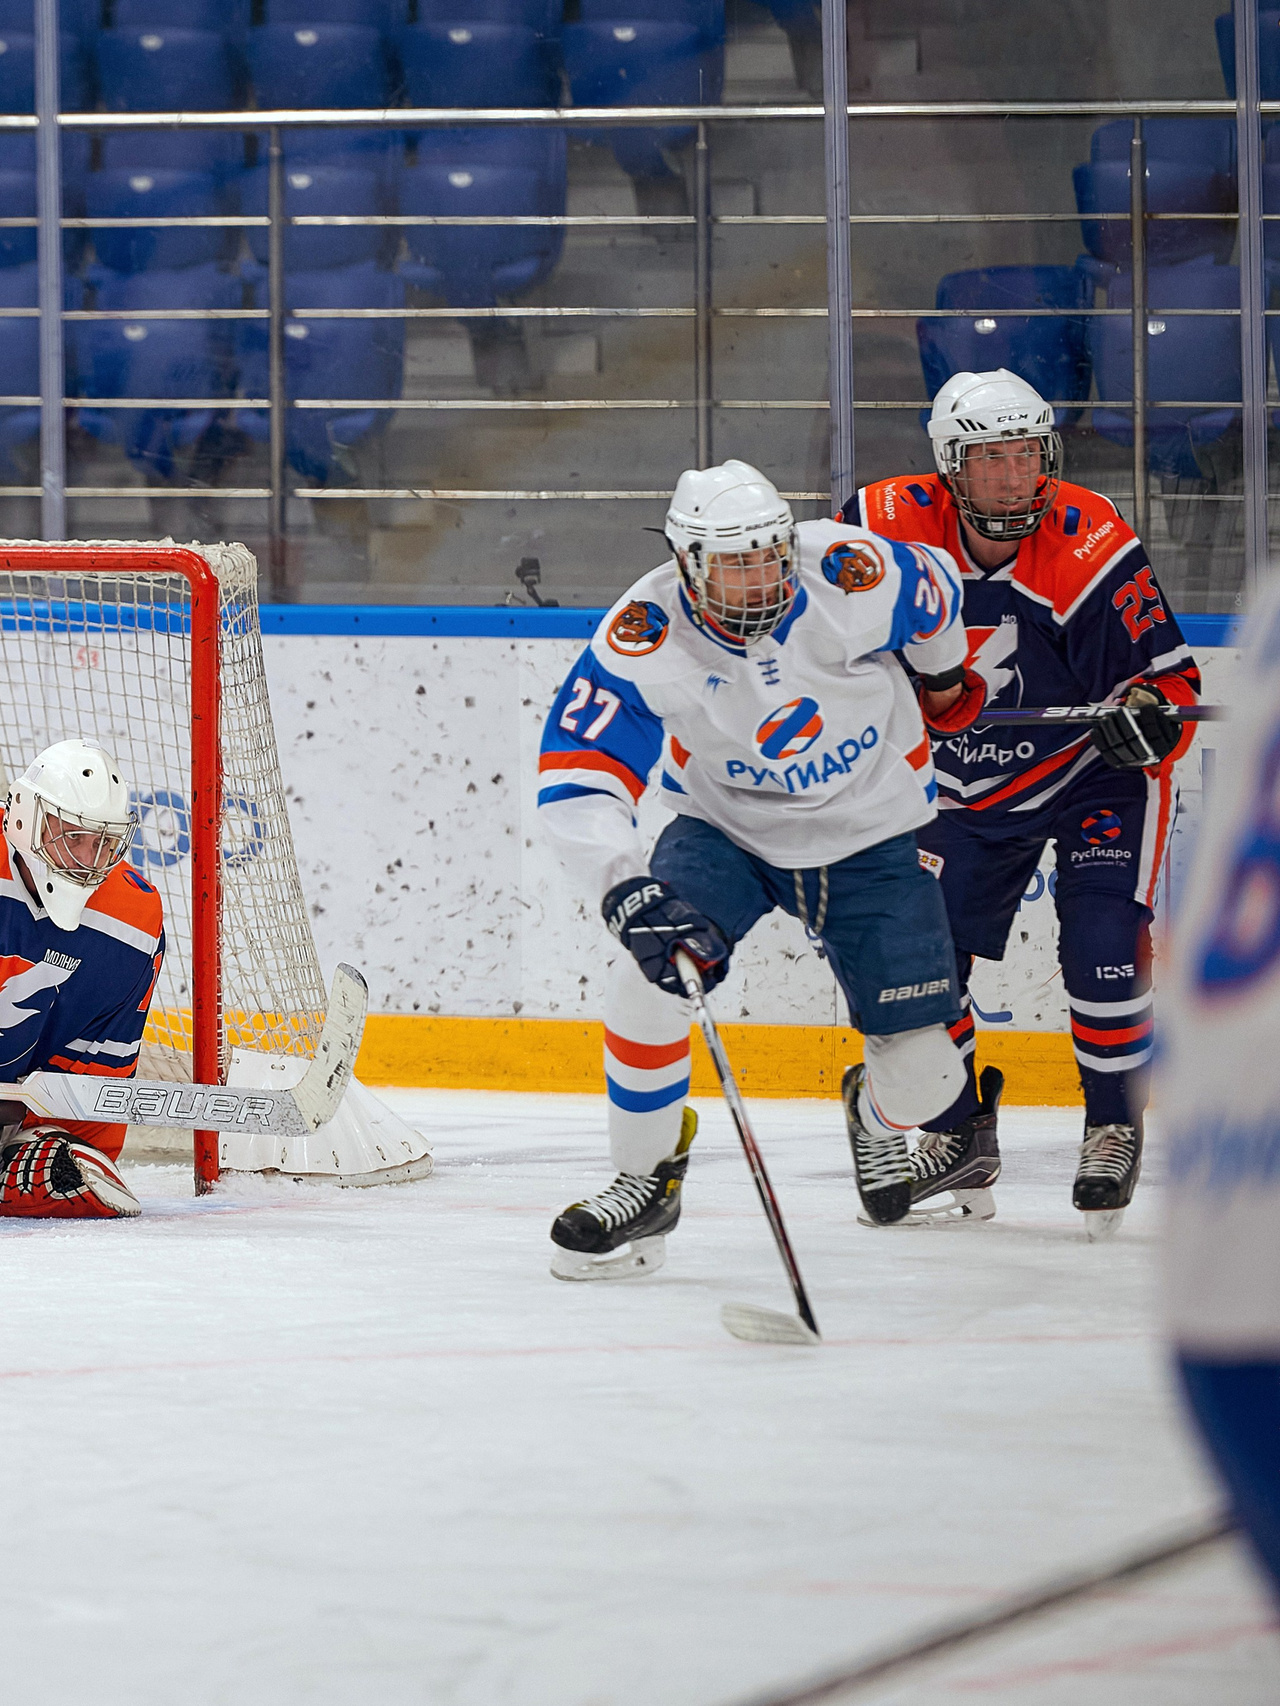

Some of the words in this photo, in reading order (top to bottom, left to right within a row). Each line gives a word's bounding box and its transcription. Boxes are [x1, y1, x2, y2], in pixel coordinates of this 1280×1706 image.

[997, 413, 1028, 423] CCM
[1072, 520, 1115, 560] РусГидро
[1111, 564, 1167, 644] 25
[559, 676, 622, 742] 27
[1070, 846, 1133, 862] РусГидро
[878, 978, 950, 1004] BAUER
[93, 1084, 275, 1127] BAUER
